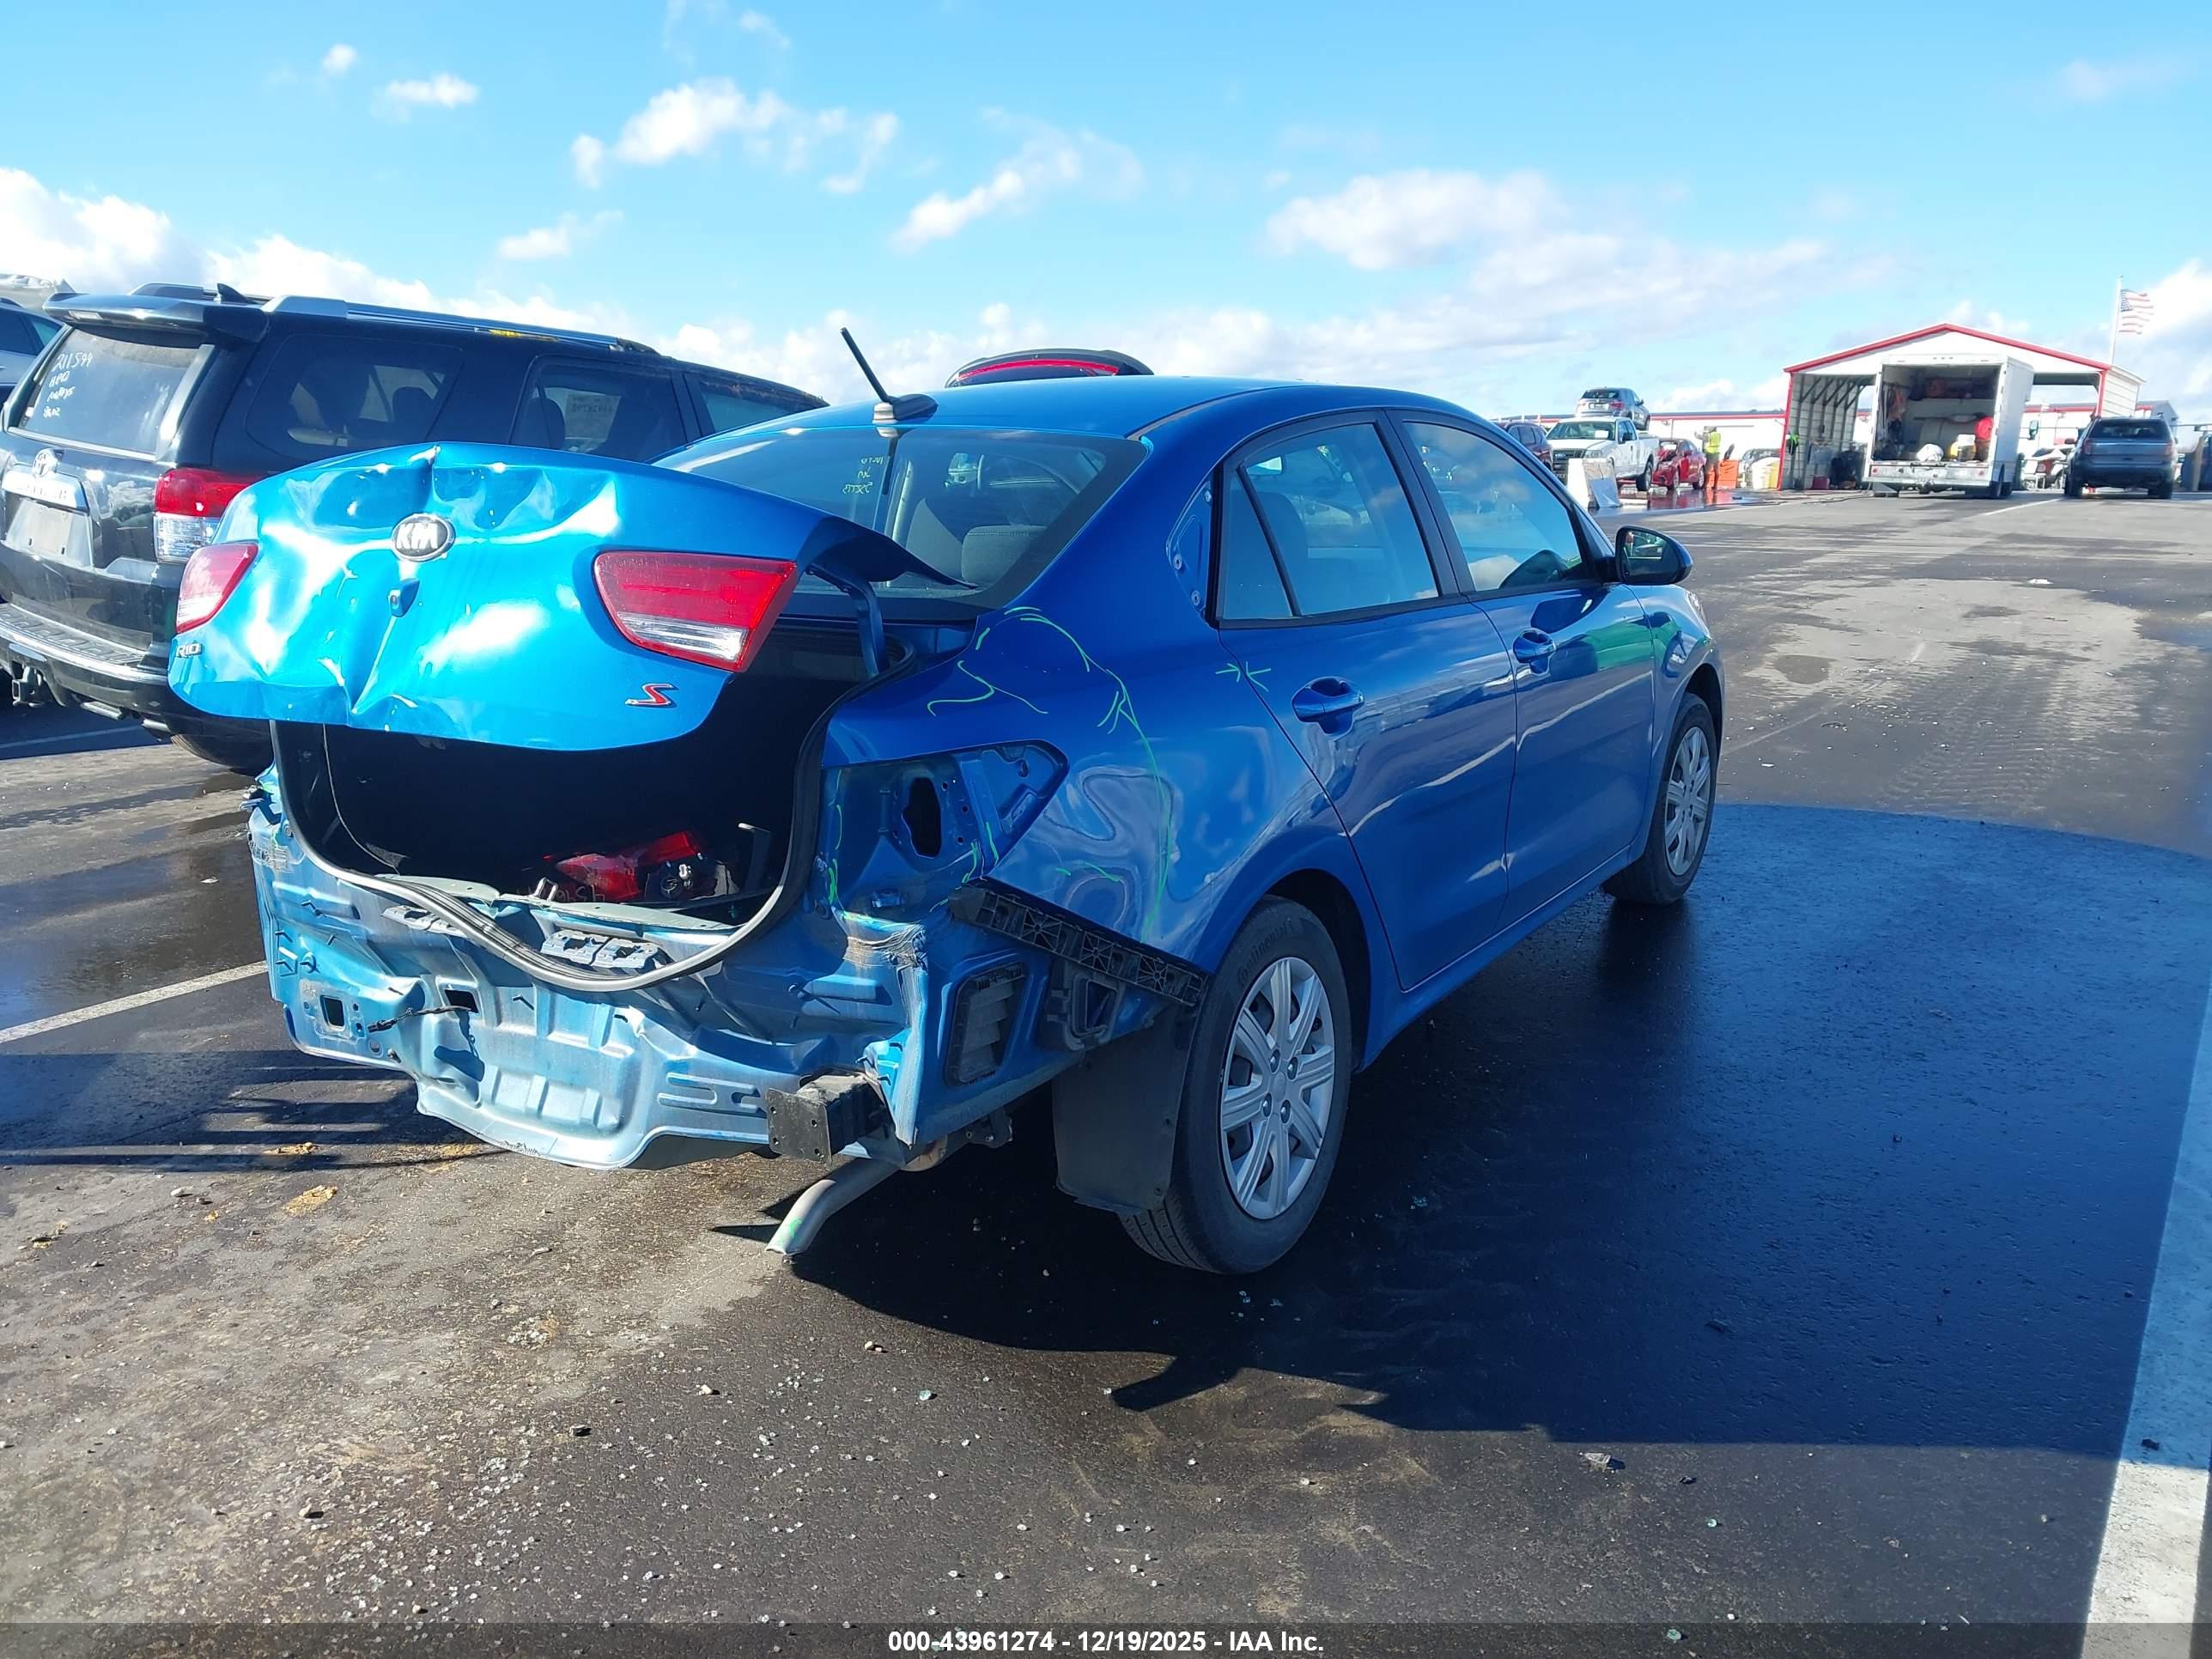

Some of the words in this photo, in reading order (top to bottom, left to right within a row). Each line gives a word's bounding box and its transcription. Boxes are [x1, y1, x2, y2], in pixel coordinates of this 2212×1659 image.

[396, 523, 439, 550] KIA
[176, 643, 202, 659] RIO
[625, 684, 674, 705] S
